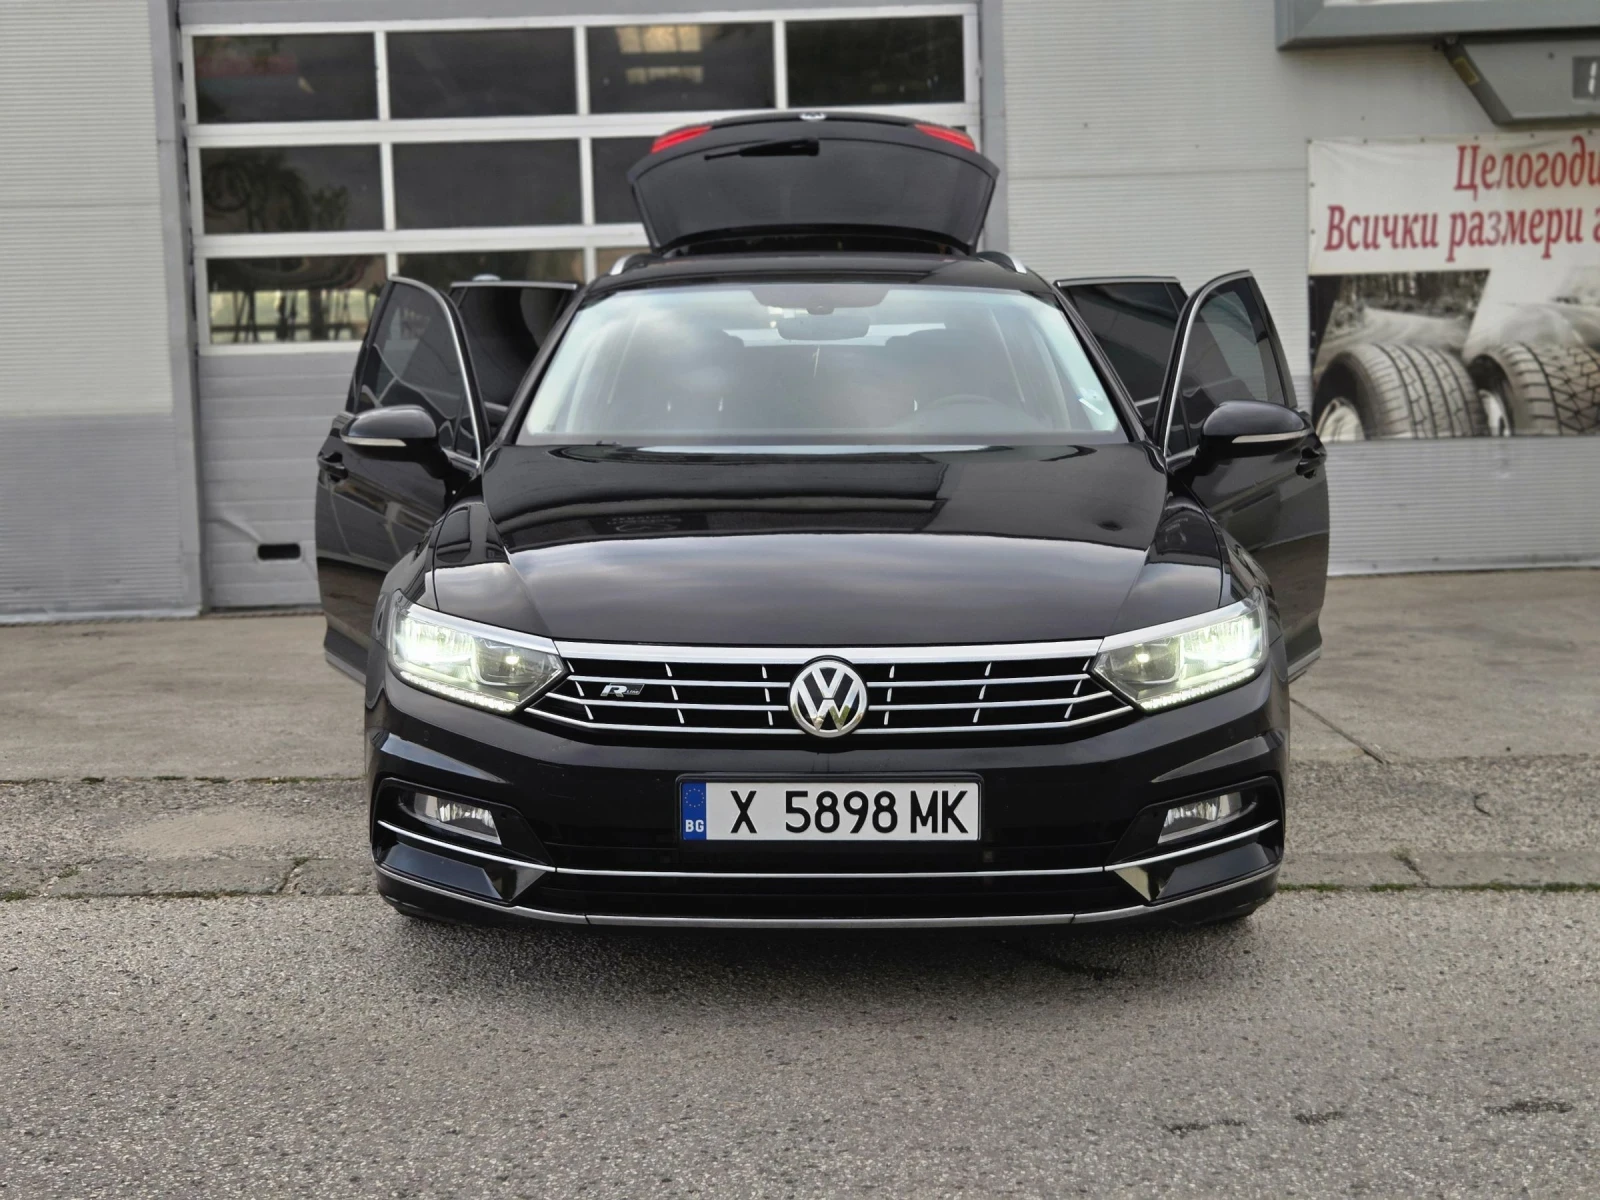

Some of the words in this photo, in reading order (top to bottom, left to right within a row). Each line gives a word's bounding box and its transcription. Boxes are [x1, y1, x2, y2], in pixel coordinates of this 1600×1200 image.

[1324, 204, 1439, 251] Всички
[1445, 207, 1583, 262] размери
[792, 659, 865, 736] VW
[685, 819, 704, 832] BG
[730, 790, 758, 834] X
[785, 790, 898, 834] 5898
[910, 790, 969, 834] MK
